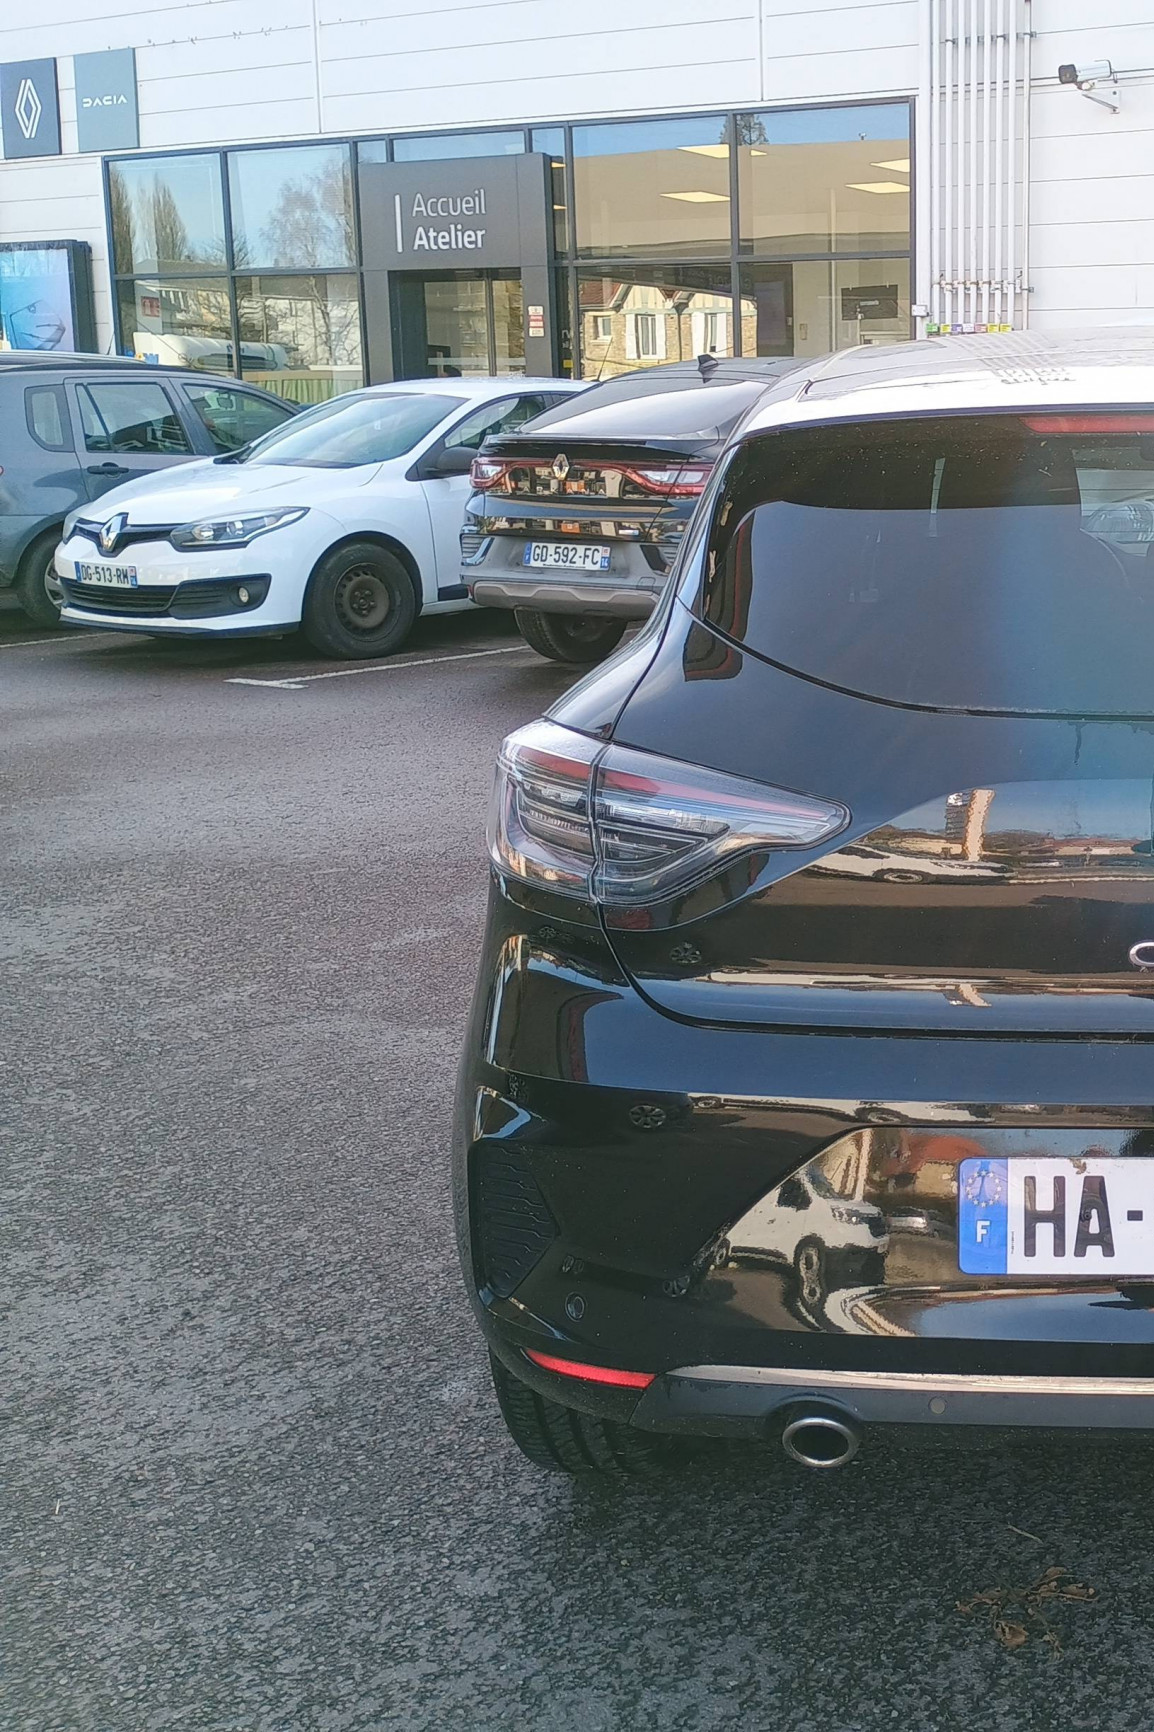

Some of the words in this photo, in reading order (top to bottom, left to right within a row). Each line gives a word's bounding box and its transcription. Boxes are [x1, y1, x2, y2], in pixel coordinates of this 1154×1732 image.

[82, 94, 127, 108] DACIA
[412, 188, 486, 217] Accueil
[413, 224, 486, 250] Atelier
[532, 545, 600, 565] GD-592-FC
[81, 564, 129, 585] DG-513-RM
[976, 1220, 991, 1243] F
